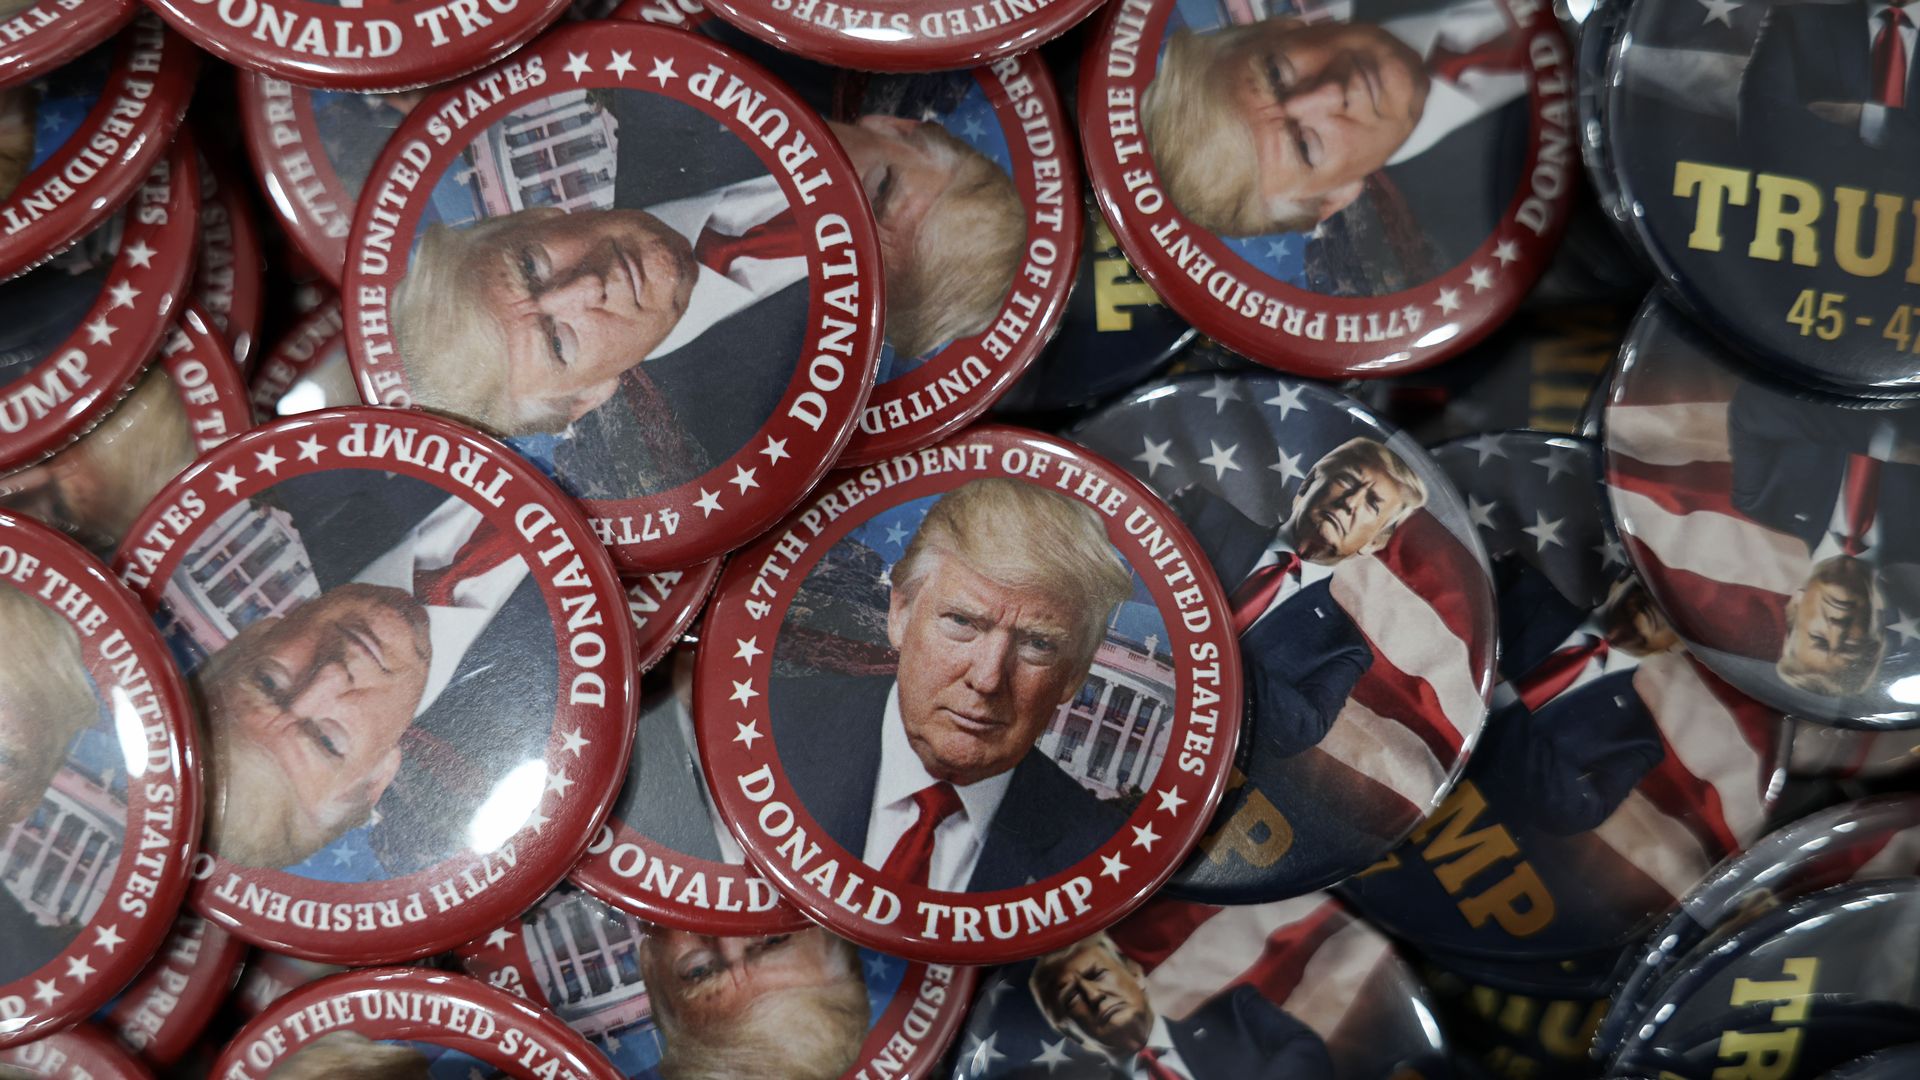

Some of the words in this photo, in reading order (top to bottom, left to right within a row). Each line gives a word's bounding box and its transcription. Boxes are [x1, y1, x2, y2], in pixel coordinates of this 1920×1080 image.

[0, 7, 61, 49] TH
[193, 0, 403, 59] ONALD
[1106, 0, 1154, 78] UNIT
[427, 55, 548, 147] STATES
[687, 63, 833, 206] TRUMP
[991, 56, 1064, 233] RESIDENT
[1107, 87, 1144, 165] THE
[1514, 31, 1573, 238] DONALD
[2, 78, 155, 236] PRESIDENT
[1122, 168, 1164, 215] OF
[360, 140, 432, 275] UNITED
[1672, 160, 1920, 286] TRU
[1024, 237, 1057, 289] OF
[1150, 218, 1327, 341] PRESIDENT
[360, 285, 395, 366] THE
[787, 212, 860, 432] DONALD
[980, 291, 1042, 362] THE
[1334, 303, 1424, 343] 47TH
[1786, 289, 1847, 341] 45
[0, 348, 93, 434] UMP
[176, 358, 220, 407] OF
[859, 354, 992, 436] UNITED
[337, 422, 514, 508] TRUMP
[120, 488, 207, 590] TATES
[587, 506, 681, 546] 47TH
[38, 567, 110, 638] THE
[514, 502, 607, 709] DONALD
[744, 530, 809, 622] 47TH
[799, 443, 994, 537] PRESIDENT
[1001, 447, 1051, 479] OF
[1055, 460, 1128, 517] THE
[1124, 505, 1213, 634] UNITED
[1177, 641, 1221, 777] STATES
[100, 628, 172, 774] UNITED
[118, 783, 175, 920] STATES
[736, 763, 902, 926] DONALD
[917, 876, 1094, 942] TRUMP
[214, 871, 428, 933] PRESIDENT
[247, 1023, 289, 1072] OF
[286, 992, 359, 1044] THE
[359, 989, 497, 1042] UNITED
[497, 1026, 584, 1080] STA
[854, 963, 955, 1080] ESIDEN
